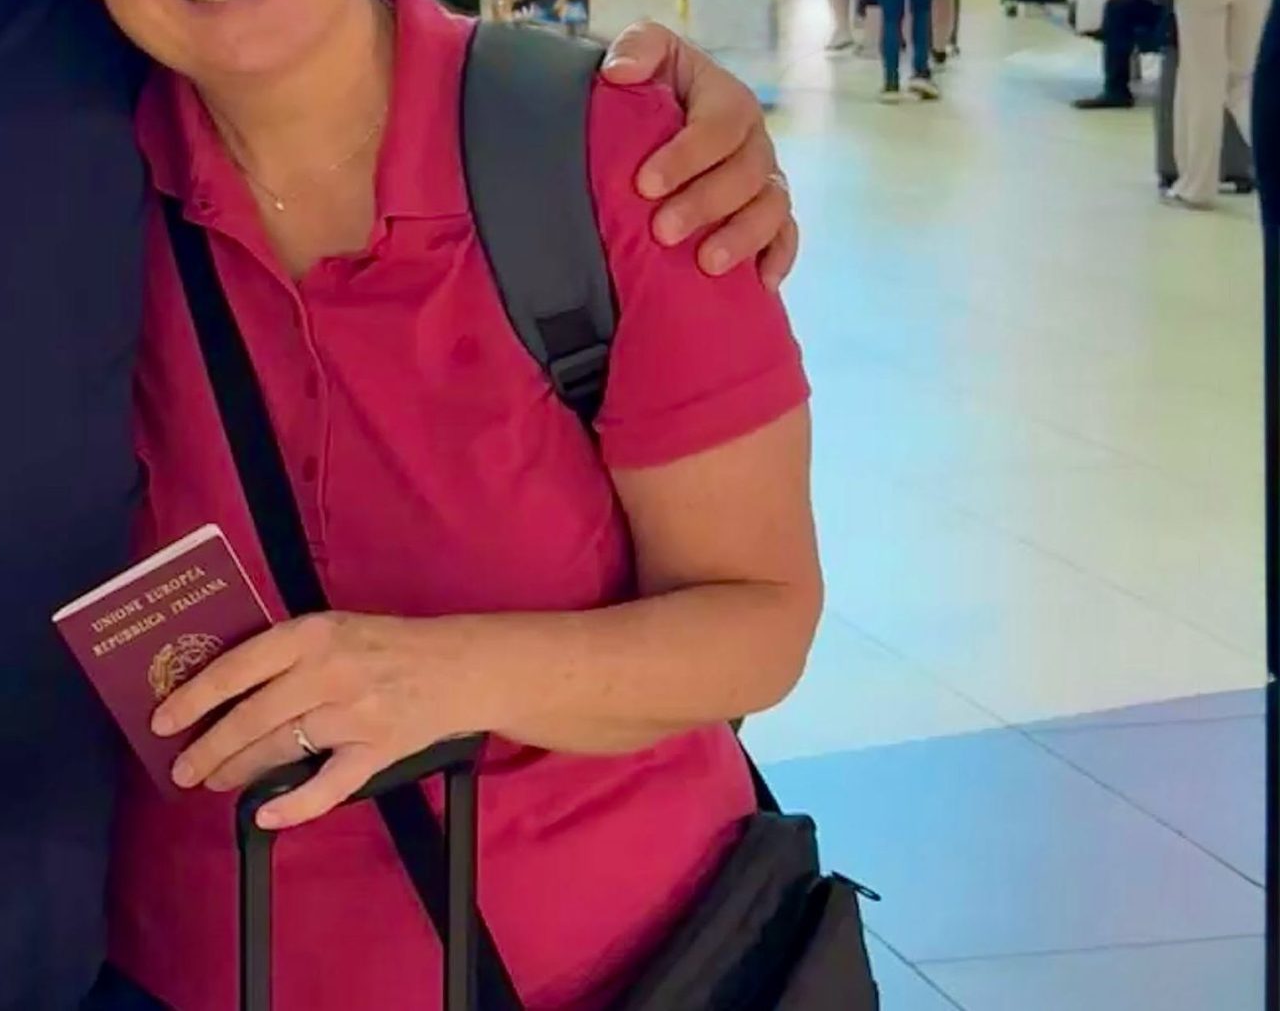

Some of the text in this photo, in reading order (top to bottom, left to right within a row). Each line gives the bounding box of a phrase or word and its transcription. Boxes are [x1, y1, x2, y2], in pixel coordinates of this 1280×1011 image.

[92, 566, 205, 632] UNIONE EUROPEA
[93, 579, 228, 657] REPUBBLICA ITALIANA
